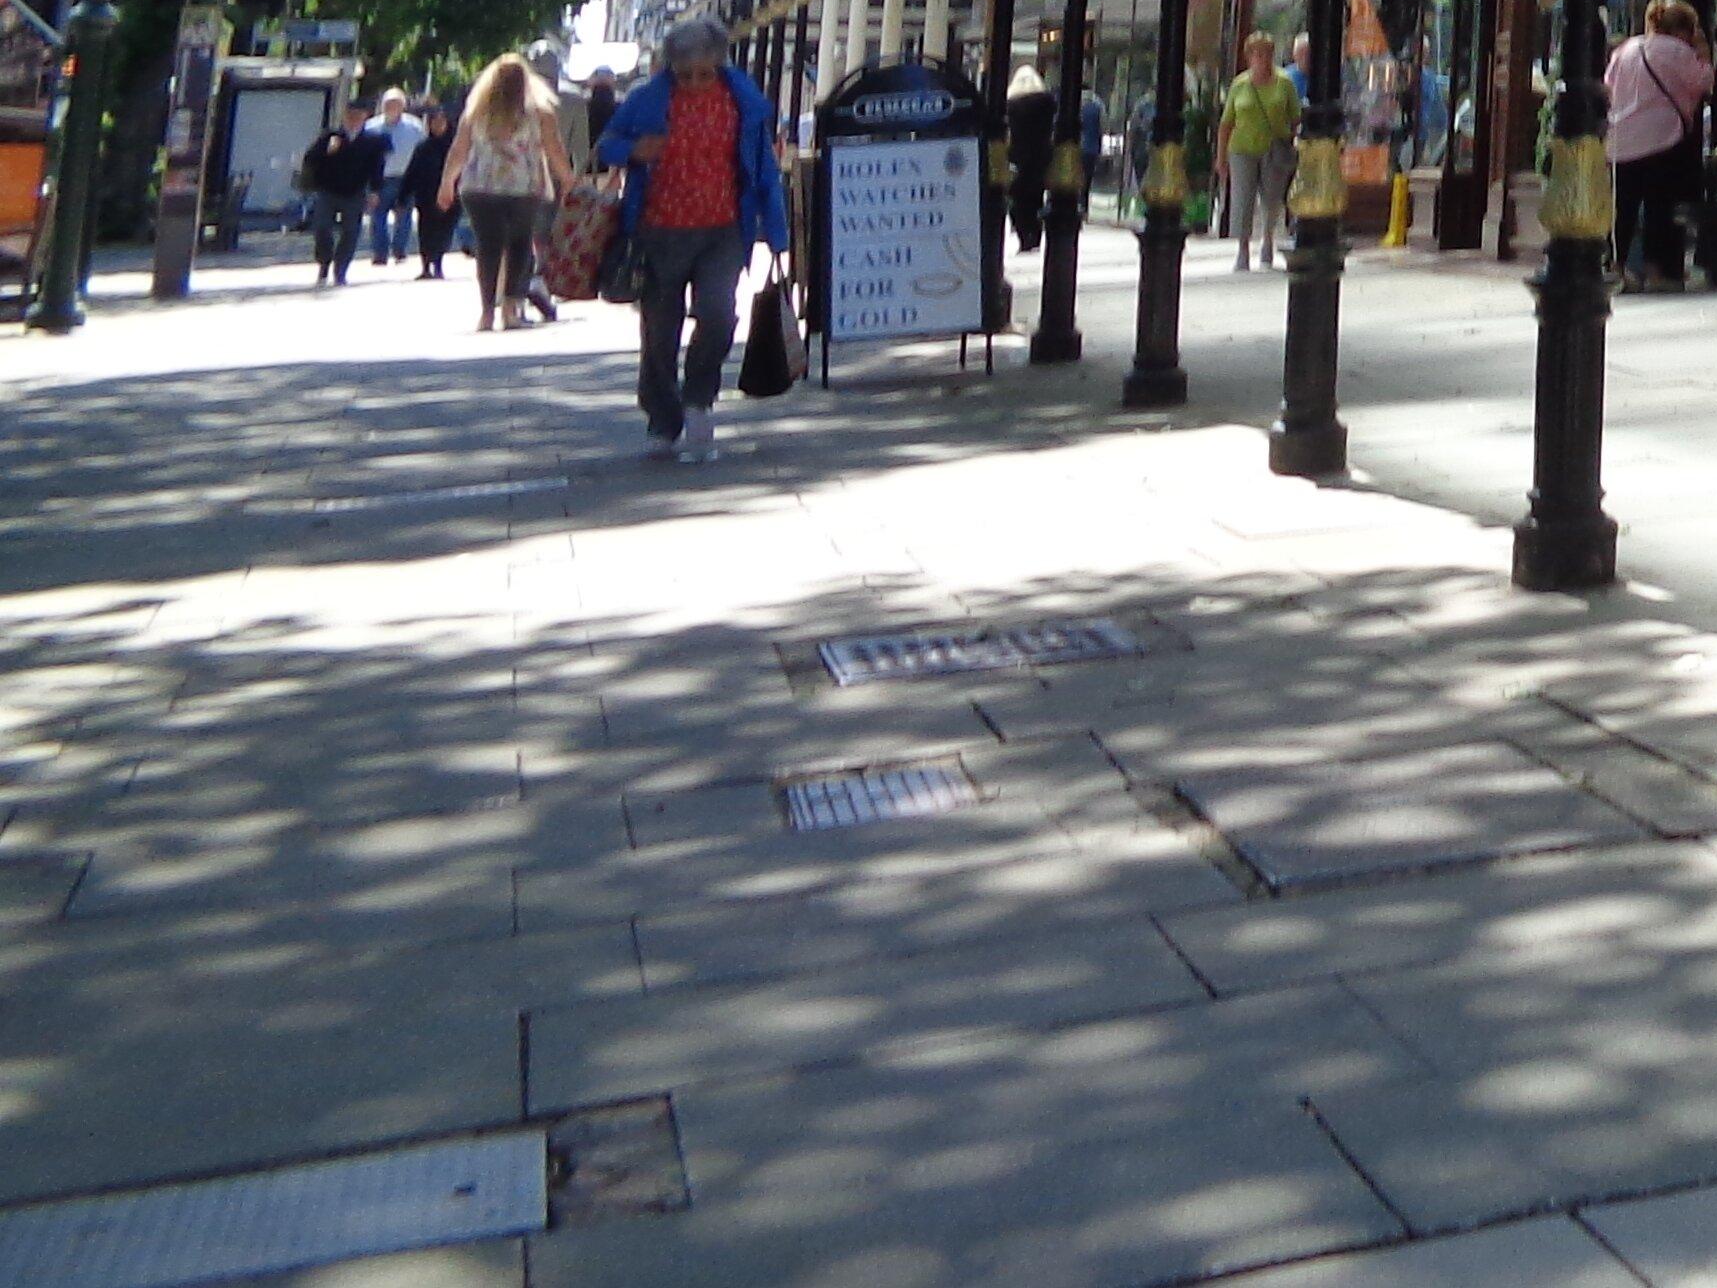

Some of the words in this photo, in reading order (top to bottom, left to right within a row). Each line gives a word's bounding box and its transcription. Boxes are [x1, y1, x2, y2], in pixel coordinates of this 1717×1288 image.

[838, 159, 922, 179] ROLEX
[838, 182, 957, 207] WATCHES
[838, 208, 944, 233] WANTED
[838, 245, 912, 271] CASH
[838, 277, 895, 301] FOR
[838, 306, 919, 330] GOLD
